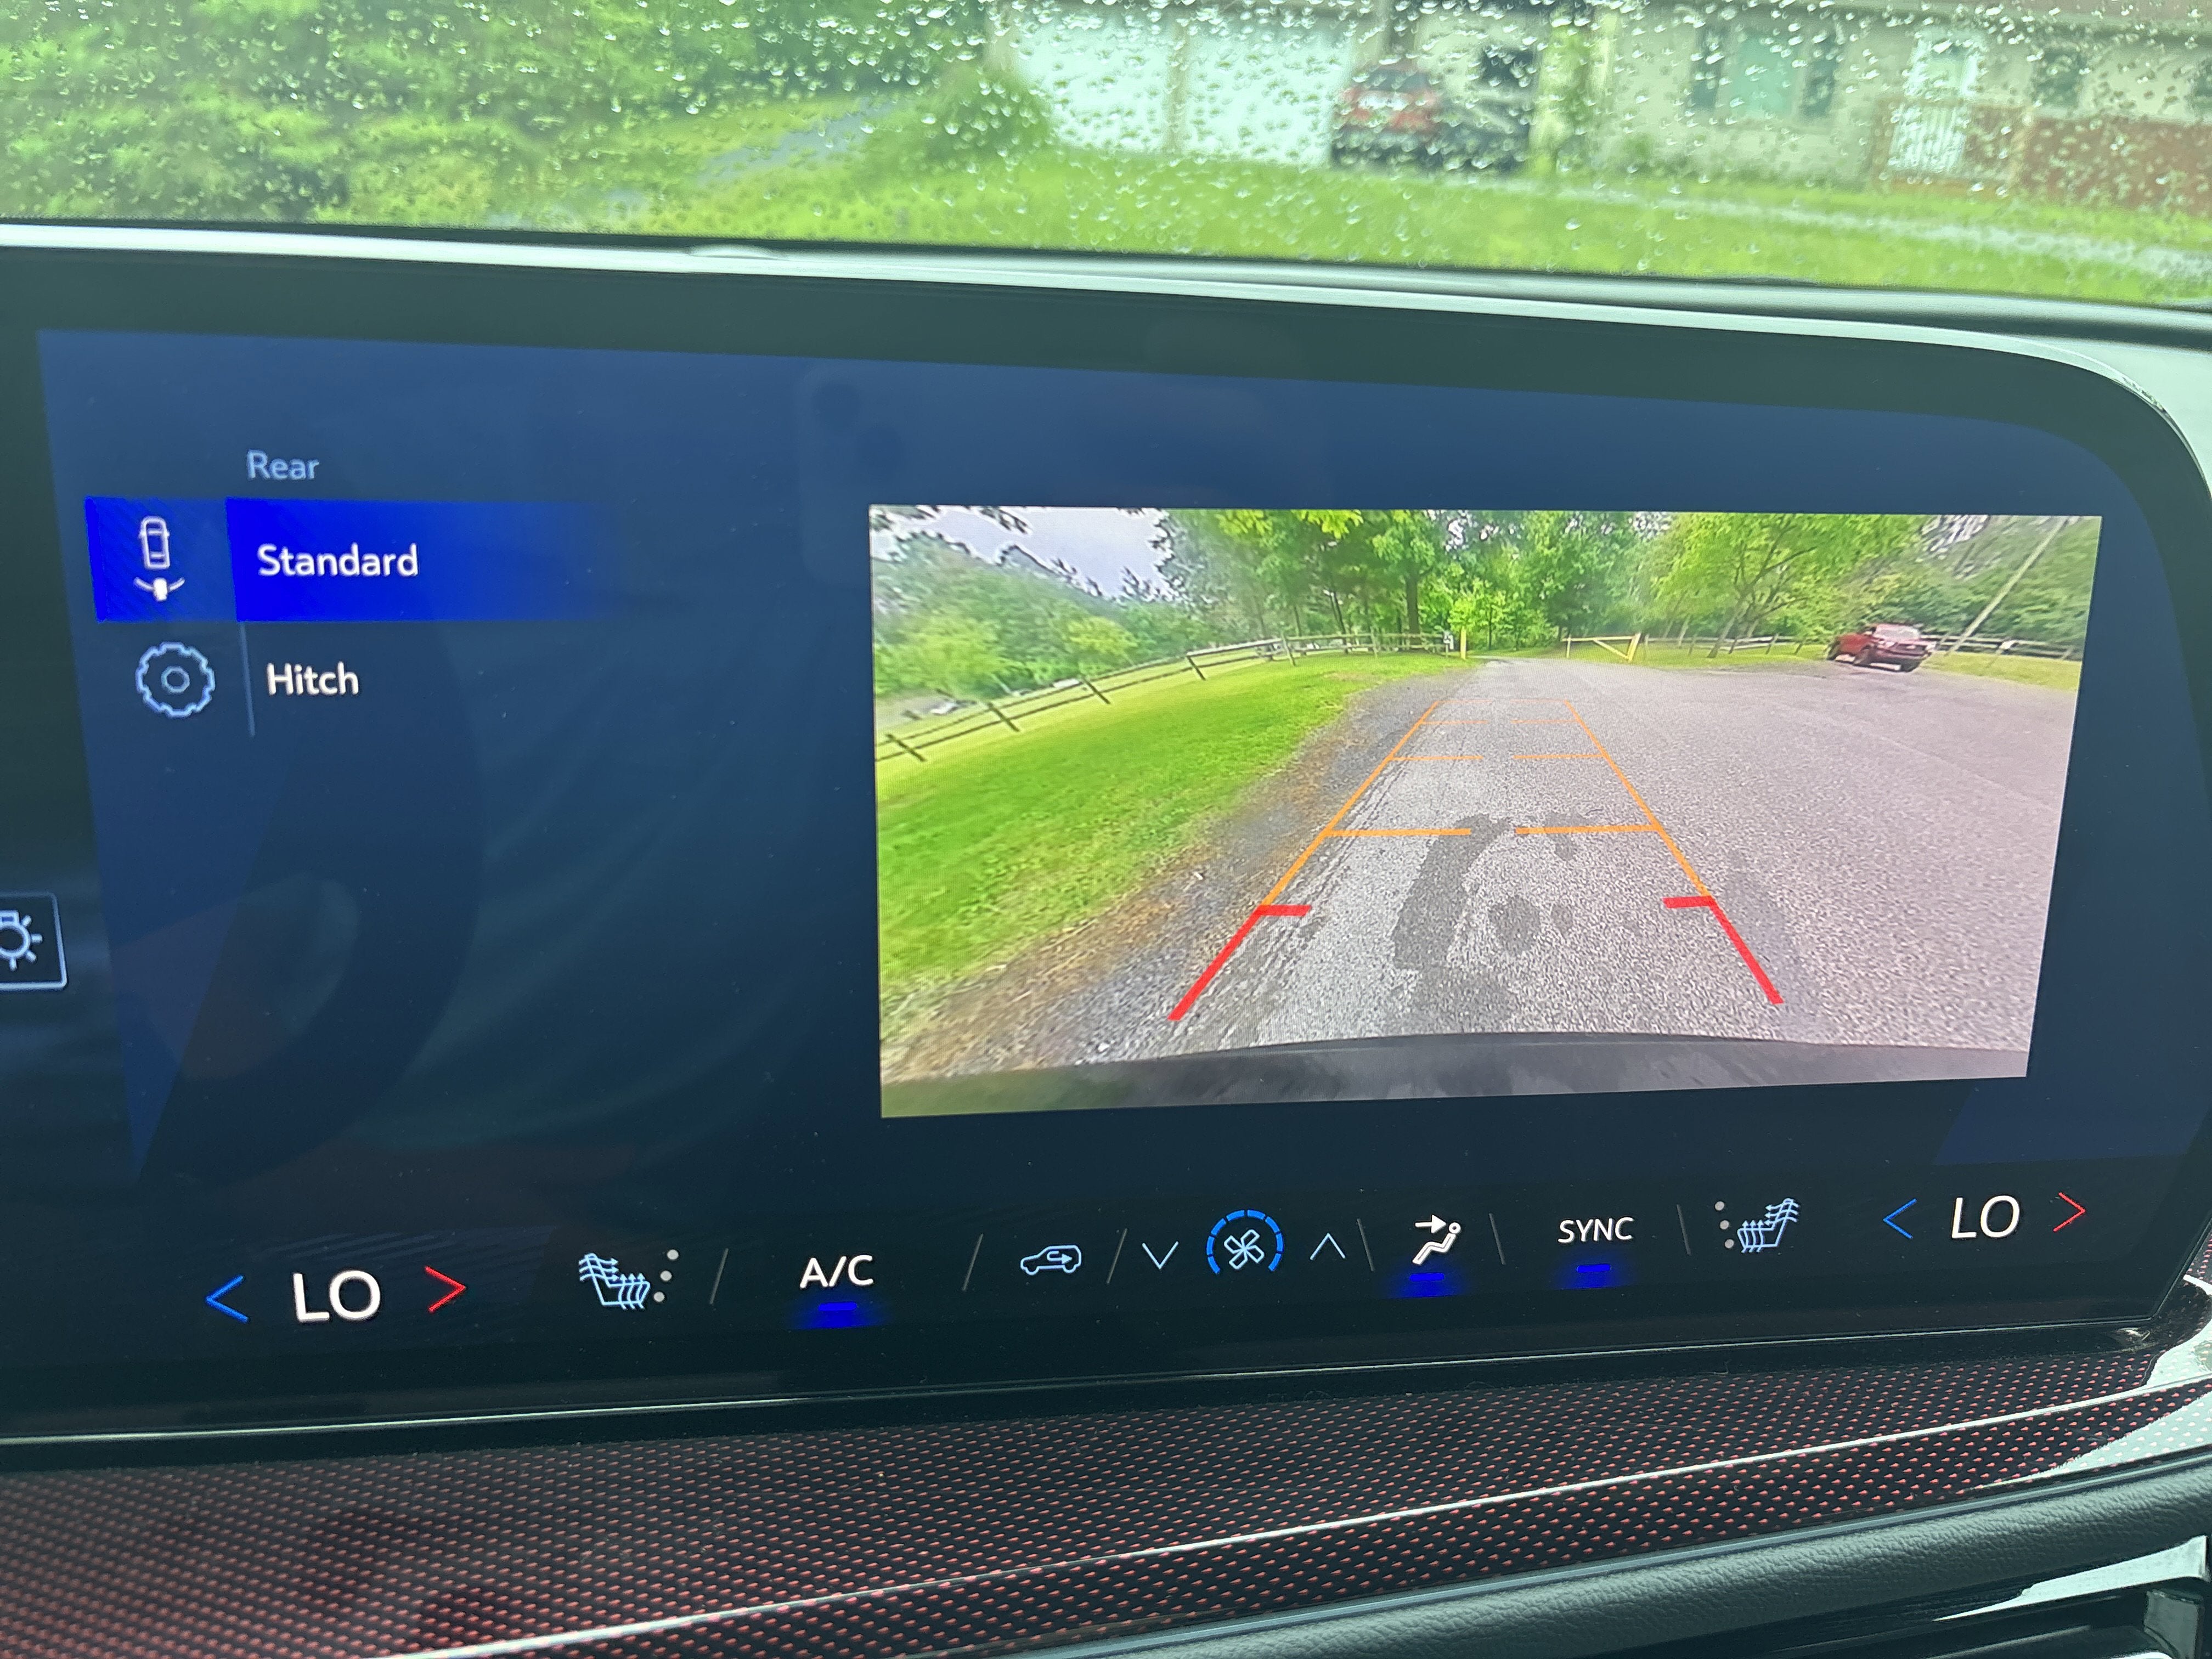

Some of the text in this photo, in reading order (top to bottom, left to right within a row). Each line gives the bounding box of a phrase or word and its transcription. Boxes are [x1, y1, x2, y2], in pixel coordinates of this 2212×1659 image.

[246, 450, 320, 480] Rear
[257, 543, 419, 577] Standard
[266, 661, 360, 695] Hitch
[1557, 1217, 1634, 1243] SYNC
[1951, 1195, 2021, 1239] LO
[799, 1254, 874, 1289] A/C
[292, 1270, 381, 1323] LO
